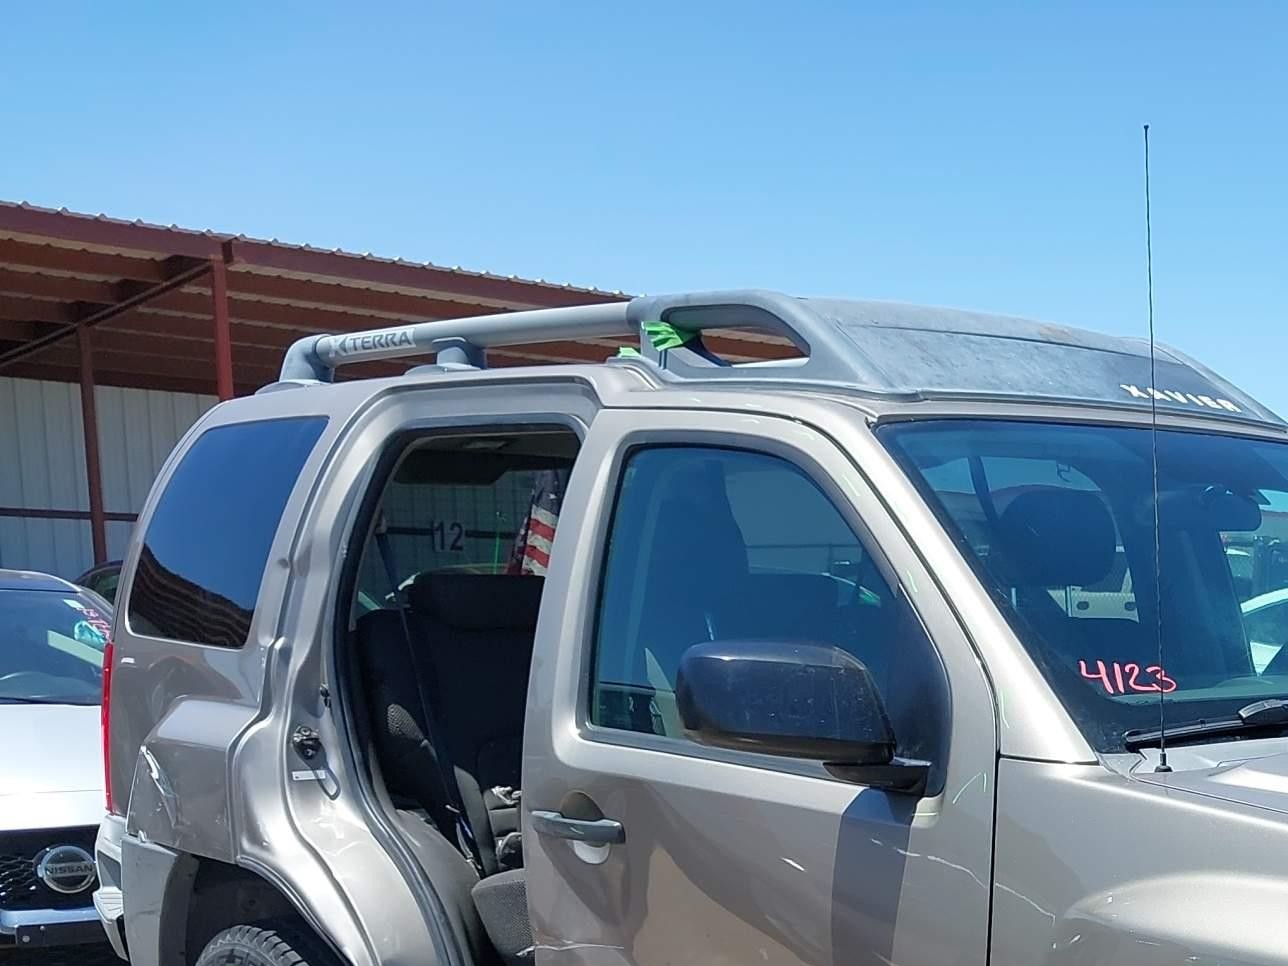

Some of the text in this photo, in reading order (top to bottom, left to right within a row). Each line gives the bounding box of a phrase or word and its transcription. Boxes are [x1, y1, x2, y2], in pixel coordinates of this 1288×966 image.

[1120, 384, 1242, 412] XAVIER
[436, 520, 464, 551] 12
[46, 864, 93, 875] NISSAN
